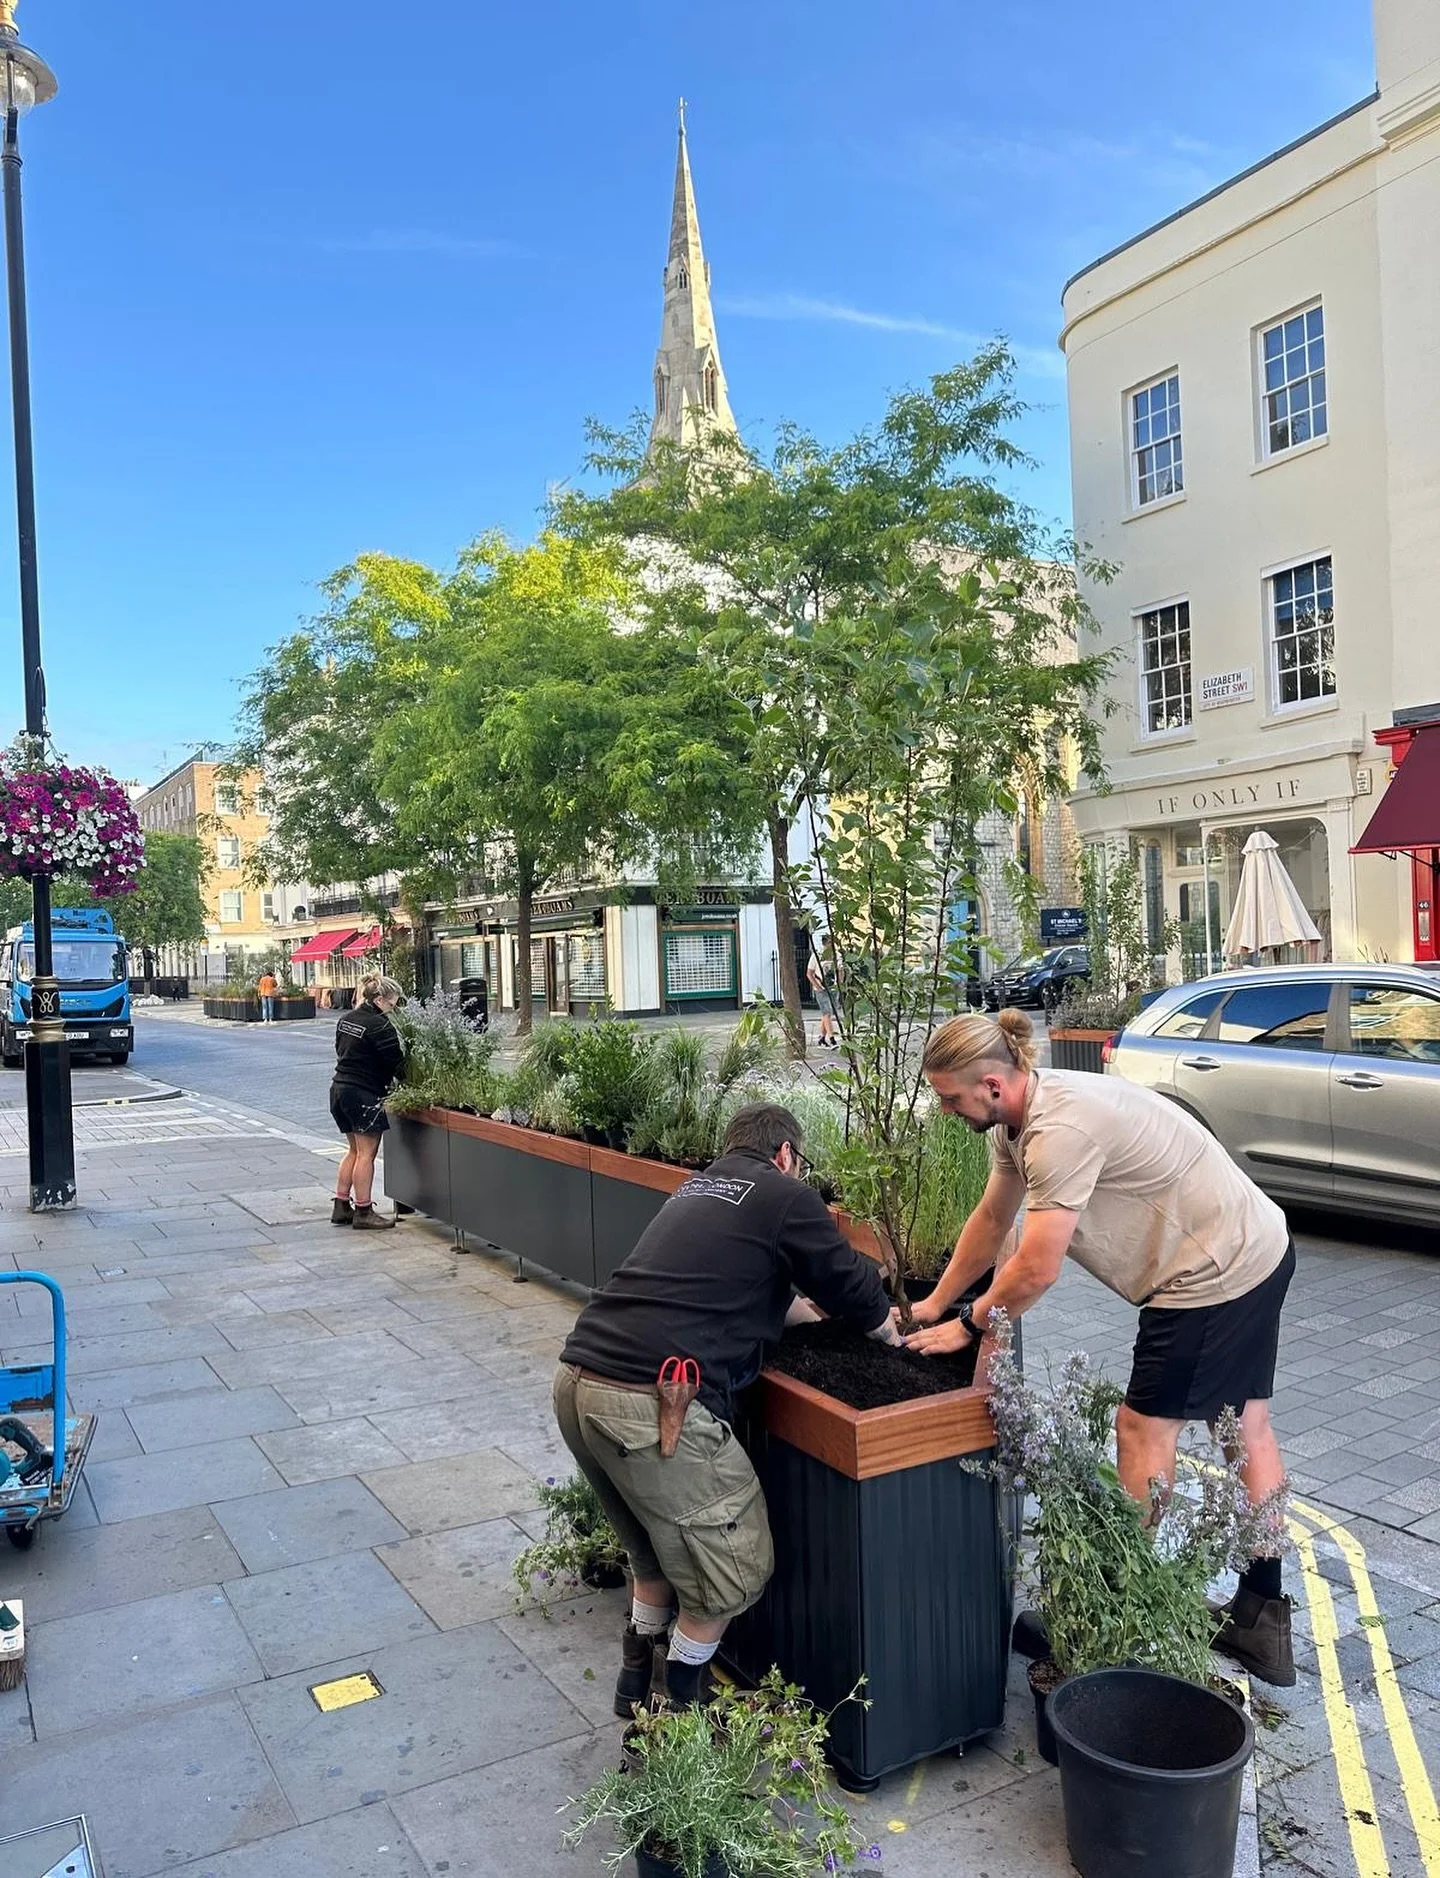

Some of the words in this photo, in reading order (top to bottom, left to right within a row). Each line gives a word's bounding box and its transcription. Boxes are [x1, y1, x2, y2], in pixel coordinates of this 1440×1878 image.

[1203, 672, 1242, 689] ELIZABETH
[1203, 685, 1231, 699] STREET
[1232, 682, 1248, 693] SW1
[1157, 796, 1179, 814] IF
[1192, 784, 1260, 810] ONLY
[1276, 779, 1300, 798] IF
